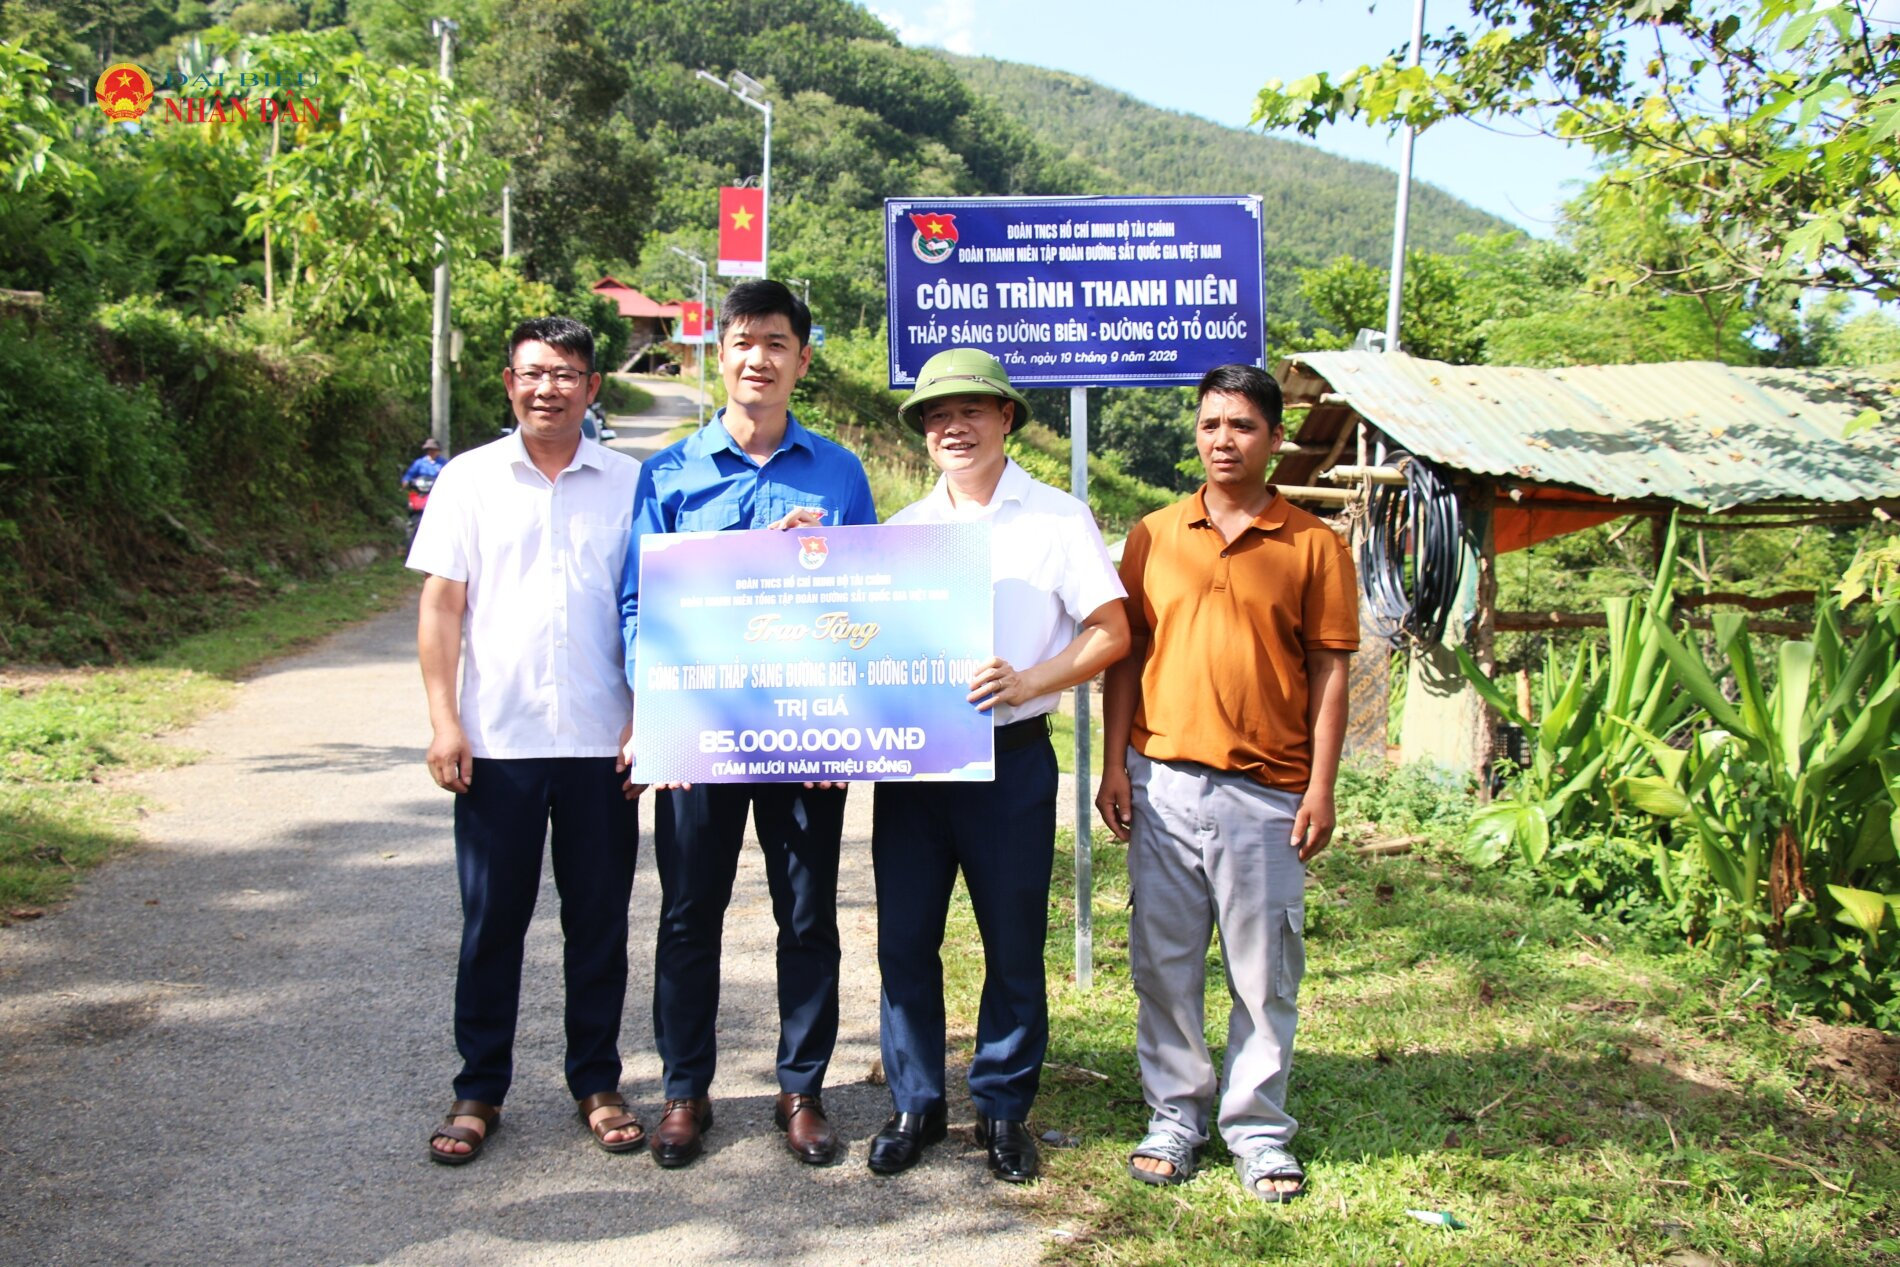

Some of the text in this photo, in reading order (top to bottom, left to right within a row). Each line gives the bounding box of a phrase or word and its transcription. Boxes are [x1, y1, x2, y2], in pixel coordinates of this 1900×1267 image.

[1007, 221, 1032, 239] ĐOÀN
[1034, 224, 1058, 239] TNCS
[1074, 220, 1089, 239] CHÍ
[1091, 223, 1115, 238] MINH
[1117, 219, 1130, 241] BỘ
[1131, 219, 1146, 238] TÀI
[1147, 219, 1175, 238] CHÍNH
[959, 244, 983, 262] ĐOÀN
[985, 248, 1015, 262] THANH
[1016, 244, 1039, 262] NIÊN
[1040, 244, 1057, 264] TẬP
[1059, 243, 1084, 261] ĐOÀN
[1085, 242, 1117, 261] ĐƯỜNG
[1118, 240, 1135, 260] SẮT
[1137, 240, 1161, 261] QUỐC
[1162, 245, 1178, 260] GIA
[1179, 241, 1199, 262] VIỆT
[1200, 244, 1222, 259] NAM
[916, 273, 1238, 310] CÔNG TRÌNH THANH NIÊN
[907, 313, 948, 344] THẮP
[951, 319, 993, 344] SÁNG
[996, 318, 1051, 343] ĐƯỜNG
[1053, 317, 1088, 342] BIÊN
[1099, 316, 1154, 342] ĐƯỜNG
[1157, 315, 1178, 341] CỜ
[1181, 309, 1202, 340] TỔ
[1204, 312, 1248, 340] QUỐC
[1029, 351, 1058, 366] ngày
[1060, 351, 1073, 364] 19
[1074, 350, 1108, 365] tháng
[1110, 350, 1119, 363] 9
[1121, 350, 1145, 362] năm
[1148, 350, 1178, 362] 2026
[811, 611, 880, 650] Tặng
[648, 661, 679, 690] CÔNG
[682, 660, 716, 690] TRÌNH
[719, 655, 748, 689] THẮP
[751, 658, 783, 689] SÁNG
[829, 656, 857, 687] BIÊN
[867, 655, 908, 686] ĐƯỜNG
[911, 653, 928, 686] CỜ
[930, 648, 946, 685] TỔ
[774, 694, 849, 720] TRỊ GIÁ
[699, 727, 926, 753] 85.000.000 VNĐ
[712, 755, 912, 777] (TÁM MƯƠI NĂM TRIỆU ĐỒNG)
